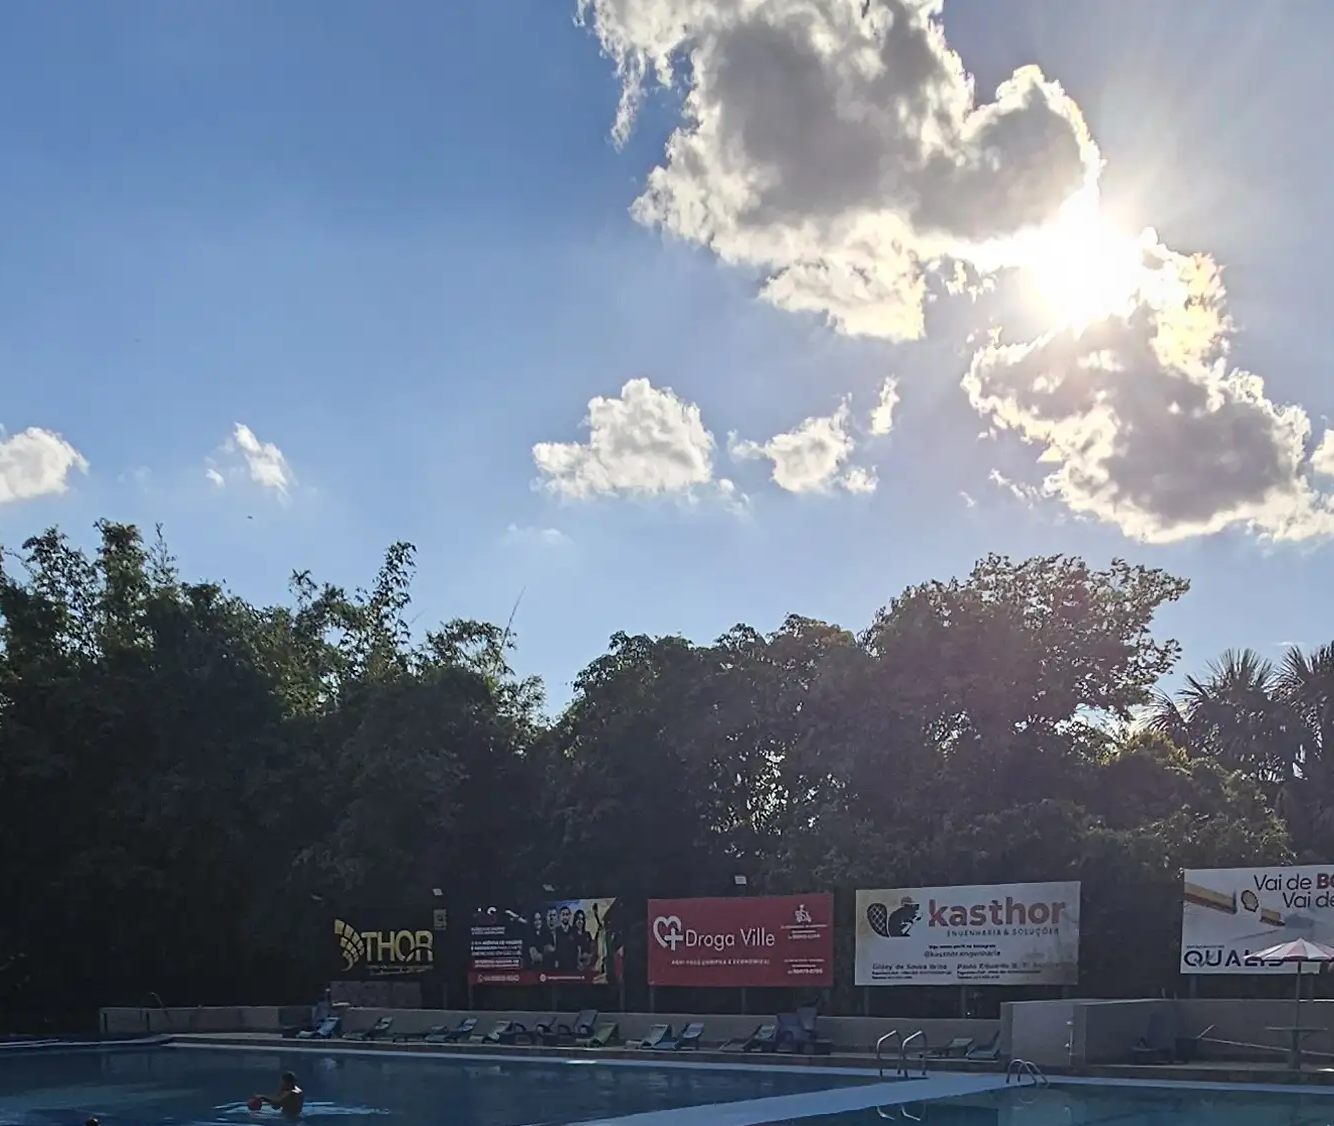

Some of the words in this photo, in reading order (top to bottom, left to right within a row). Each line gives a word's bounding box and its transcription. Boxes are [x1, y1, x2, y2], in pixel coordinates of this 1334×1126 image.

[1253, 873, 1282, 891] Vai
[1286, 873, 1312, 890] de
[928, 896, 1066, 927] kasthor
[1282, 891, 1312, 909] Vai
[361, 929, 434, 962] THOR
[685, 929, 735, 951] Droga
[740, 927, 775, 947] Ville
